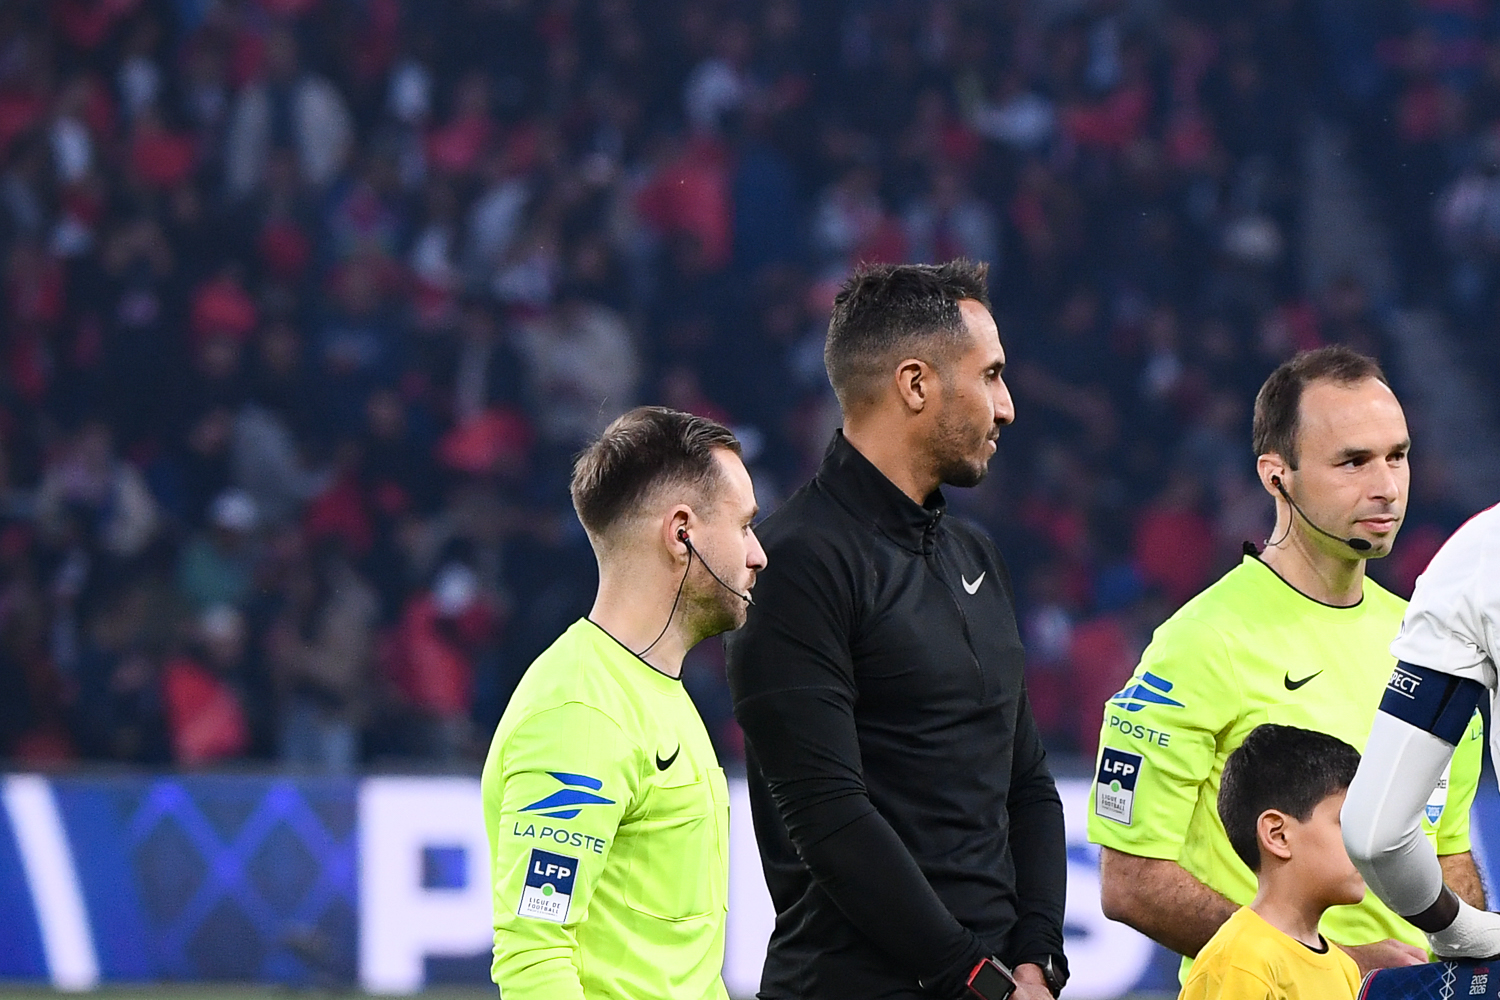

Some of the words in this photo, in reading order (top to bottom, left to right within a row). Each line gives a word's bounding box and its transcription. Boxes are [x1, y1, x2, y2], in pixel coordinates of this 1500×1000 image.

[1109, 715, 1171, 747] POSTE
[1103, 758, 1135, 777] LFP
[513, 822, 536, 838] LA
[539, 827, 606, 854] POSTE
[533, 861, 571, 879] LFP
[1471, 974, 1488, 985] 2025
[1469, 984, 1487, 995] 2026
